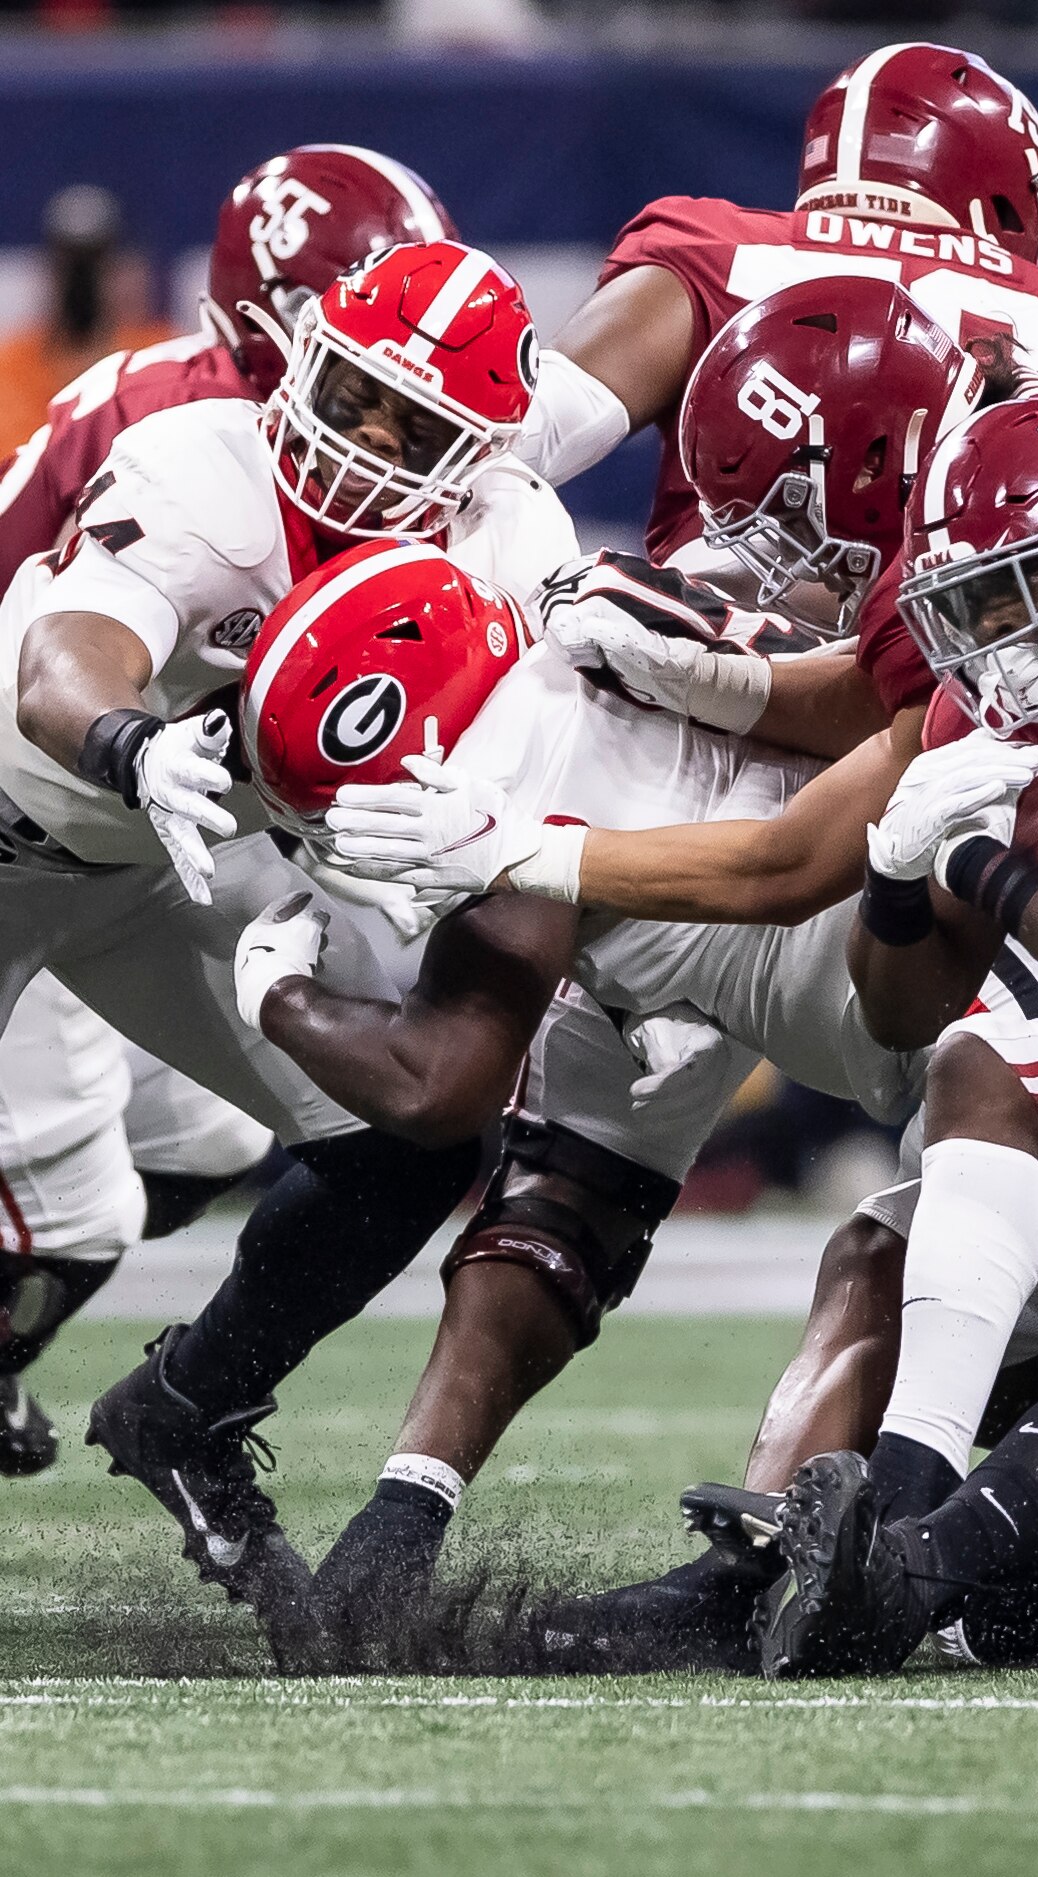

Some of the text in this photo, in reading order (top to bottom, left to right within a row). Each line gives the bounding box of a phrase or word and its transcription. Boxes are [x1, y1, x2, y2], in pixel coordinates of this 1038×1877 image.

[865, 194, 911, 216] TIDE
[806, 210, 1013, 275] OWENS
[383, 346, 434, 383] DAWGS
[737, 359, 821, 440] 81
[318, 674, 406, 766] G
[420, 1474, 457, 1499] GRIP
